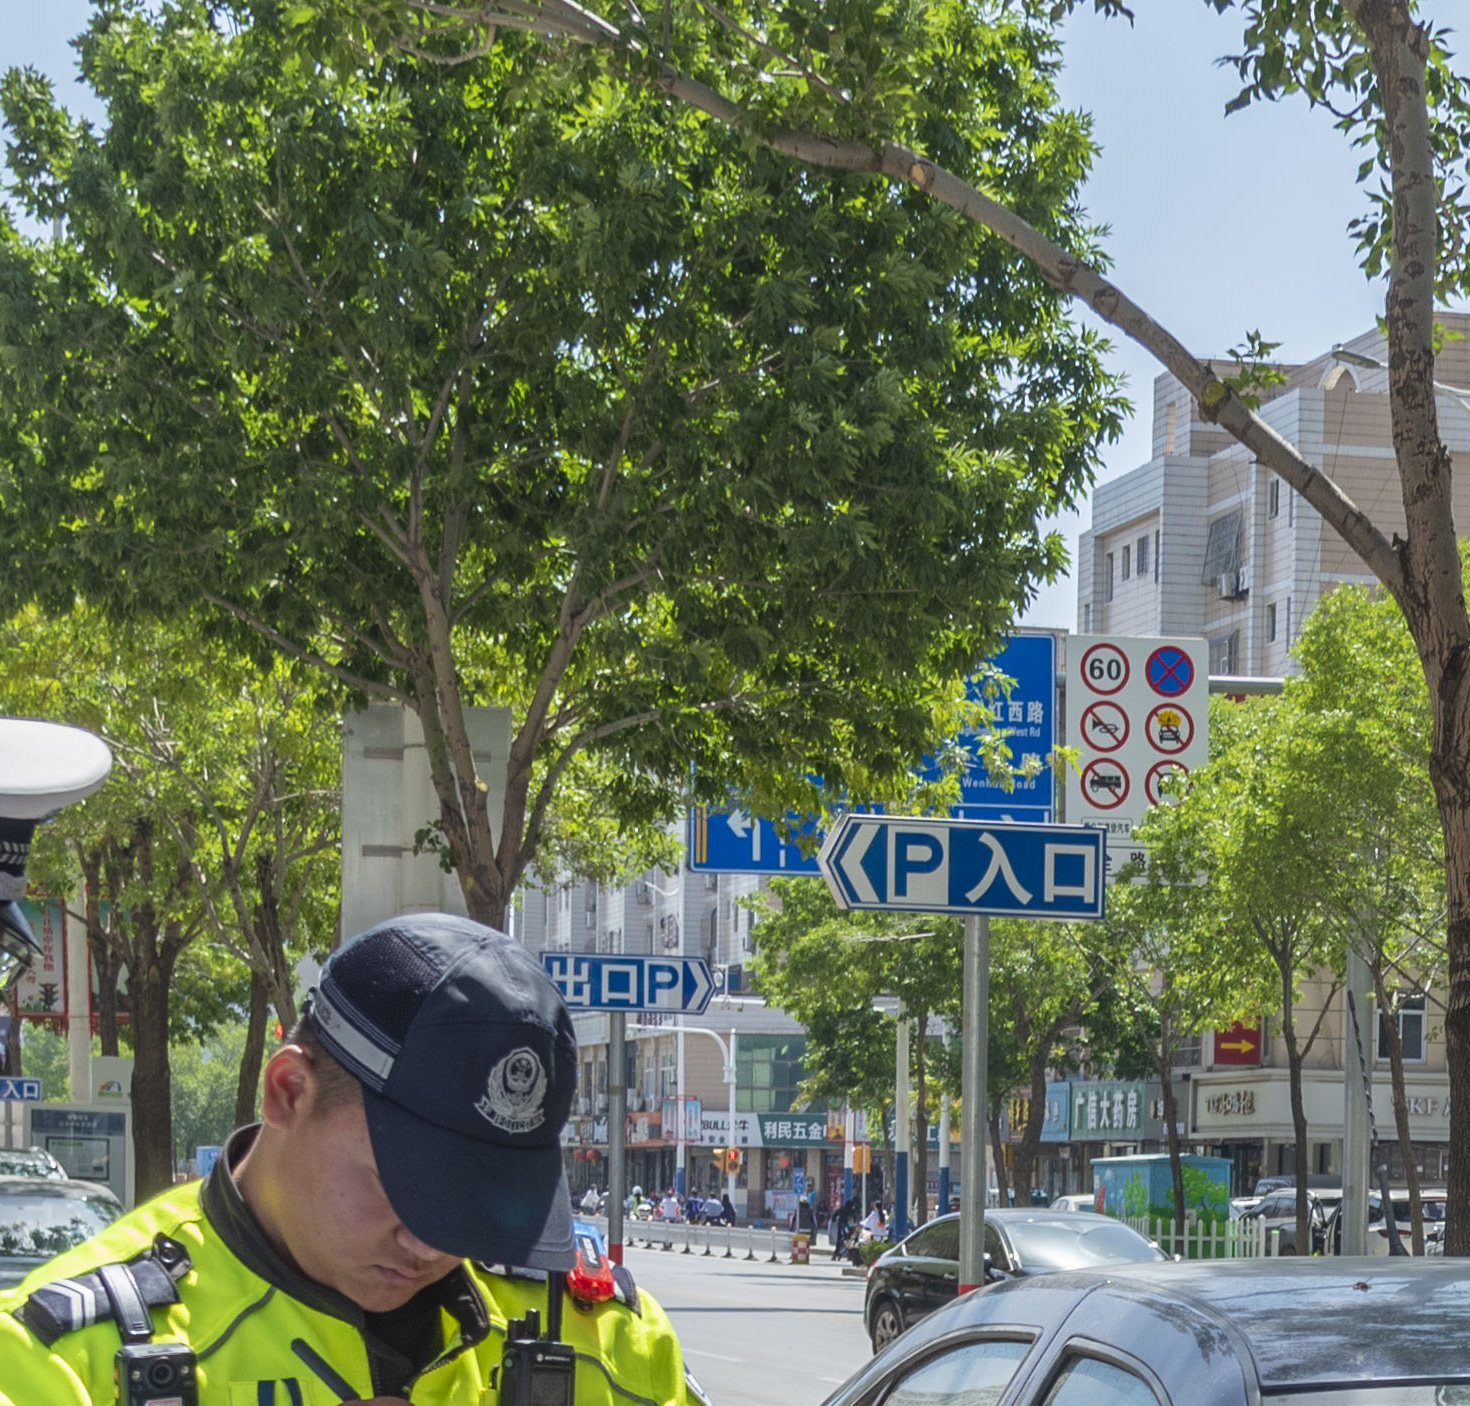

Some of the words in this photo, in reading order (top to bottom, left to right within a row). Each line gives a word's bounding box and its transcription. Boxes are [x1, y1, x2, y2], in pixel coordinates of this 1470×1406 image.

[1089, 658, 1121, 680] 60
[894, 831, 1096, 905] P入口
[552, 955, 680, 1008] 出口P
